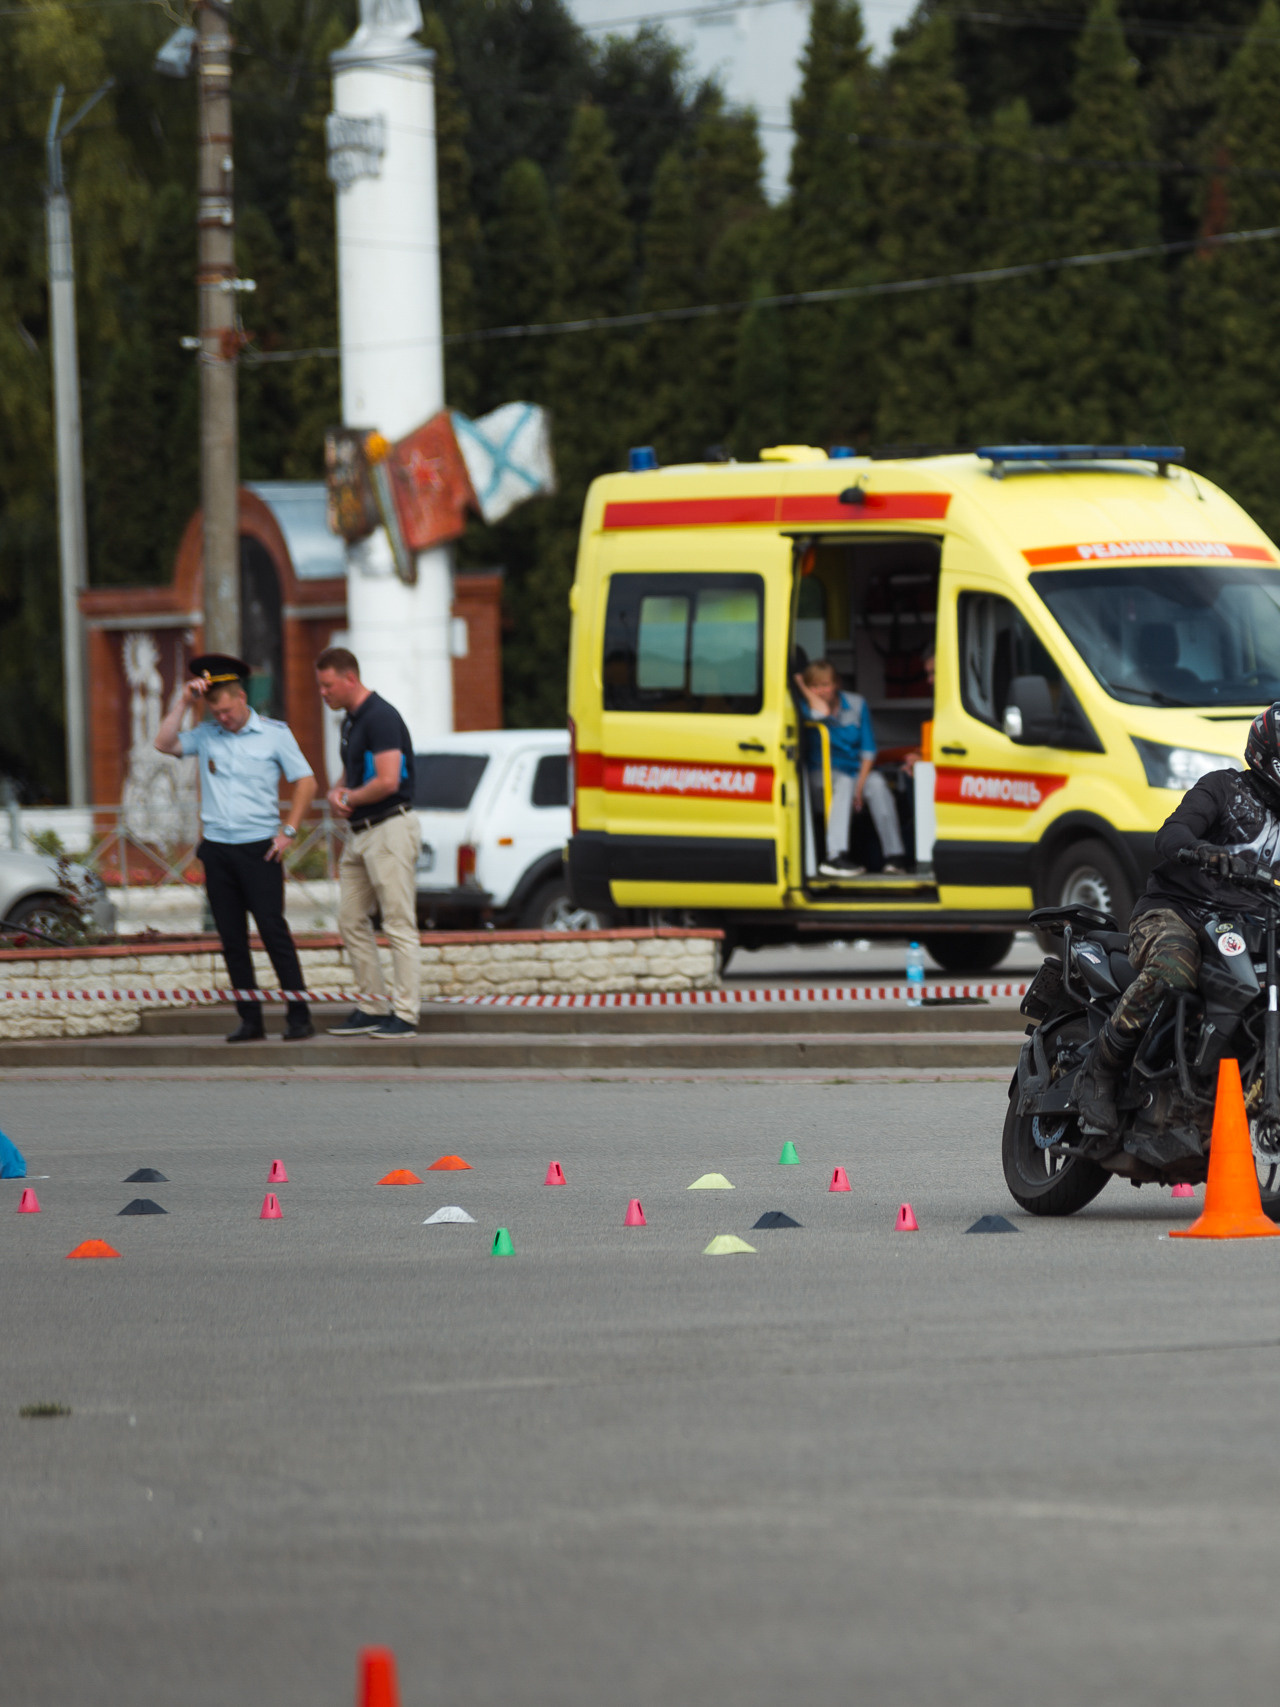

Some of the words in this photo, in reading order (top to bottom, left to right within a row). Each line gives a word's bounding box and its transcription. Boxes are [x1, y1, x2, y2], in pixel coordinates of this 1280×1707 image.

[1077, 541, 1233, 559] РЕАНИМАЦИЯ
[622, 764, 756, 794] МЕДИЦИНСКАЯ
[961, 775, 1041, 807] ПОМОЩЬ
